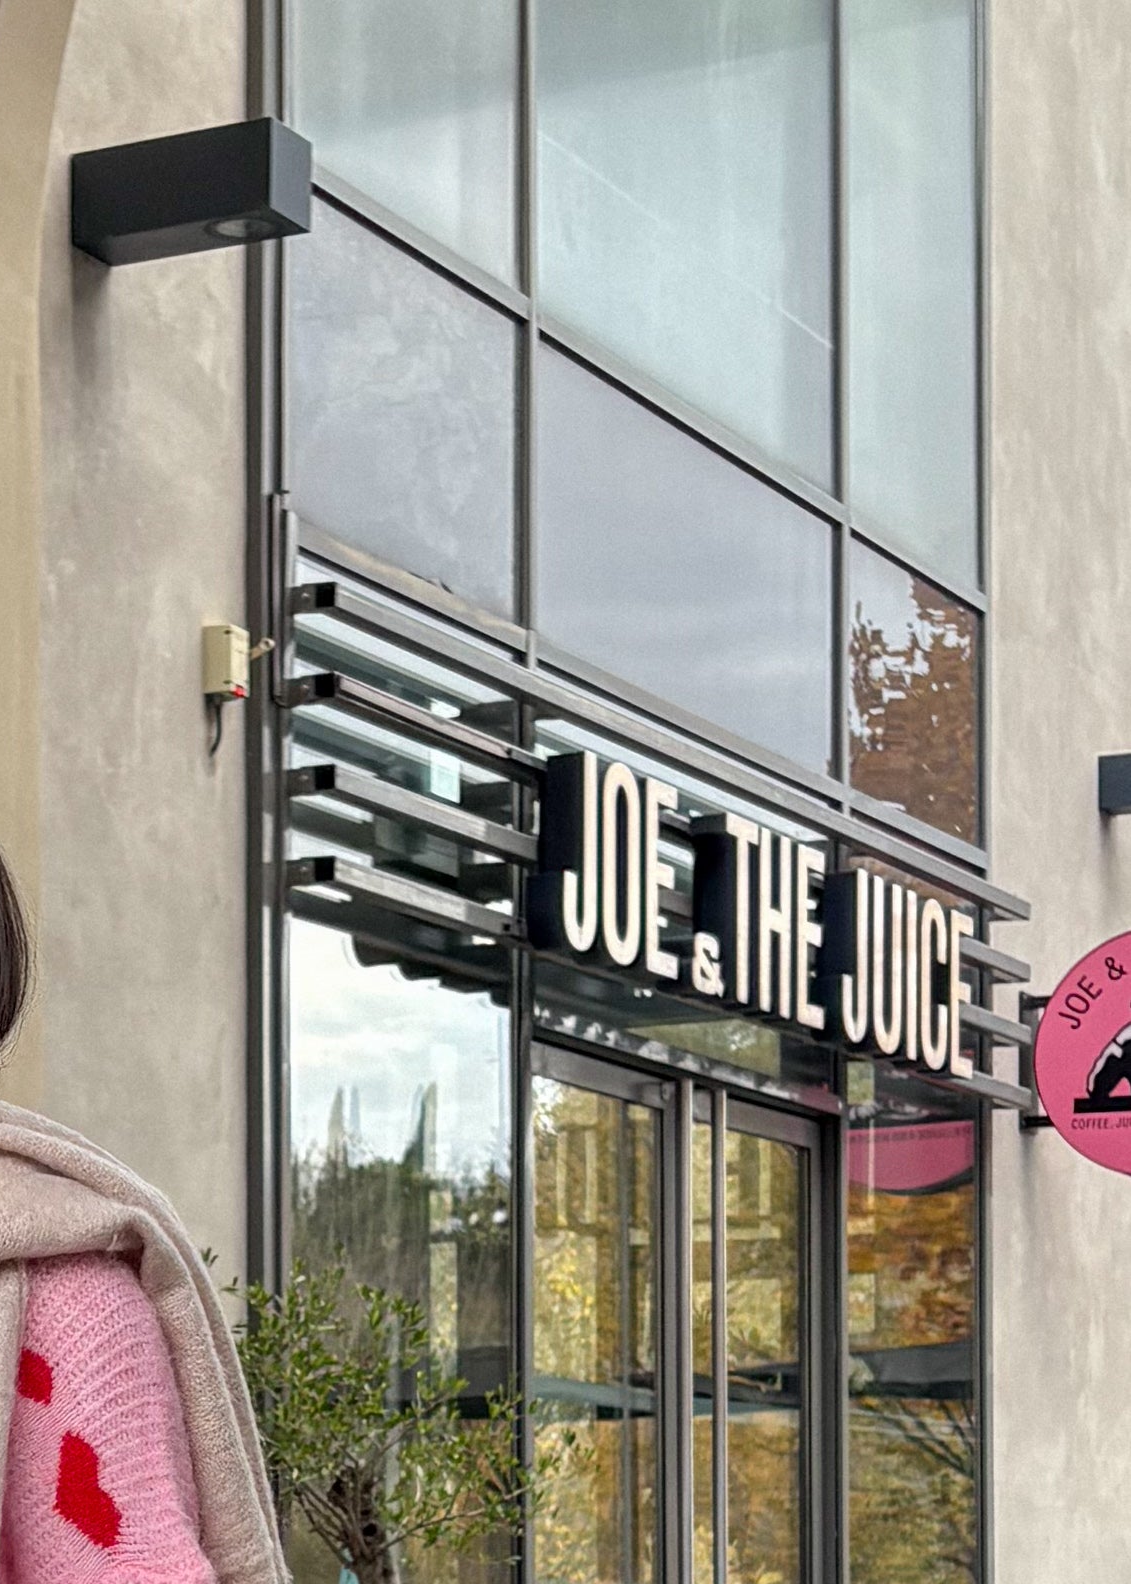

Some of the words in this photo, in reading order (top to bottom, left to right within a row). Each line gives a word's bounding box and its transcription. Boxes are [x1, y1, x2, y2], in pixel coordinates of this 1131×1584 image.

[563, 751, 678, 980] JOE
[693, 932, 724, 997] &
[726, 812, 825, 1030] THE
[842, 867, 973, 1079] JUICE
[1058, 975, 1103, 1029] JOE
[1104, 956, 1128, 980] &
